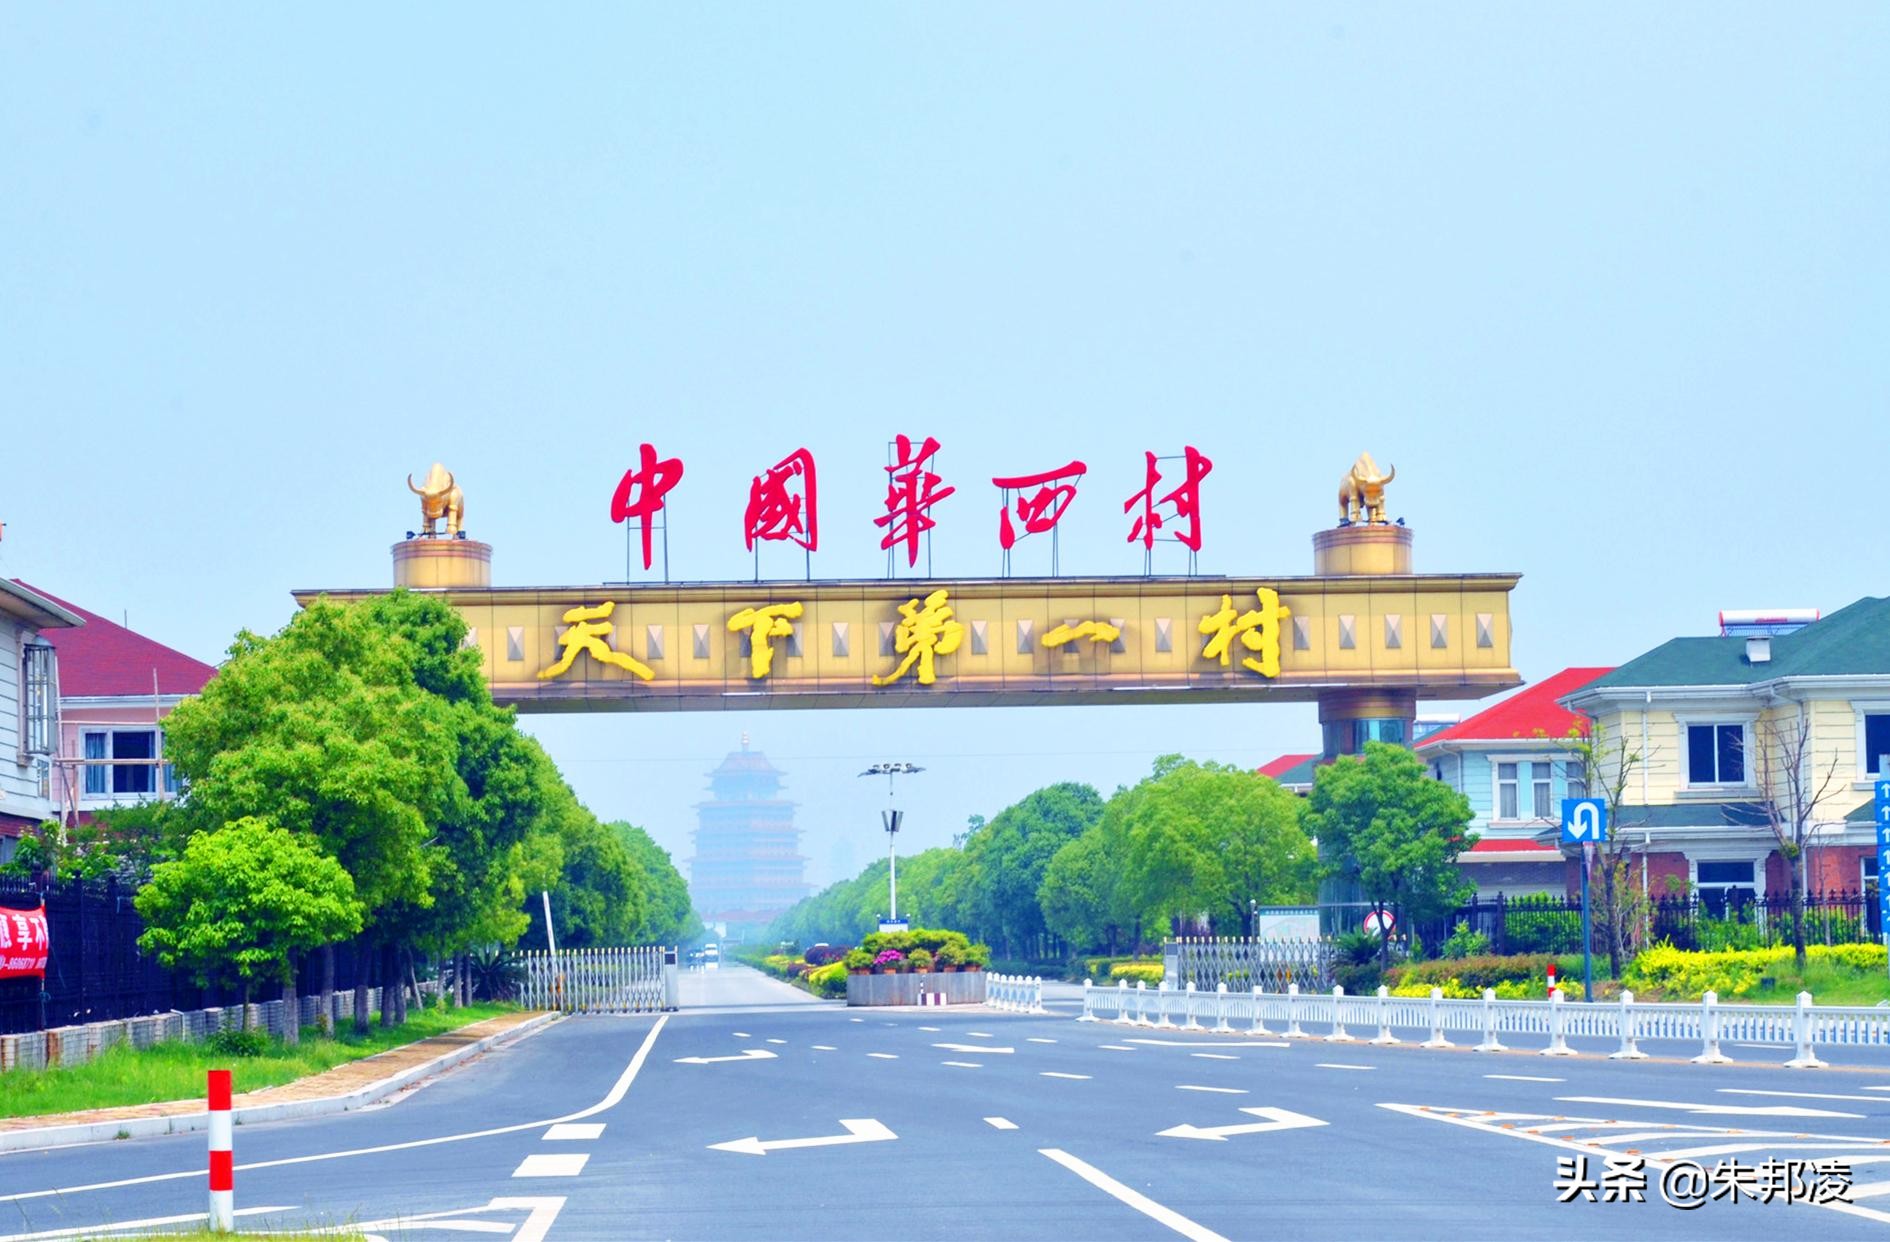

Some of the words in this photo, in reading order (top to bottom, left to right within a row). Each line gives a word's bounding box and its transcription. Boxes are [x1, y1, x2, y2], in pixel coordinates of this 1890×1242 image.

[537, 588, 1291, 685] 天下第一村
